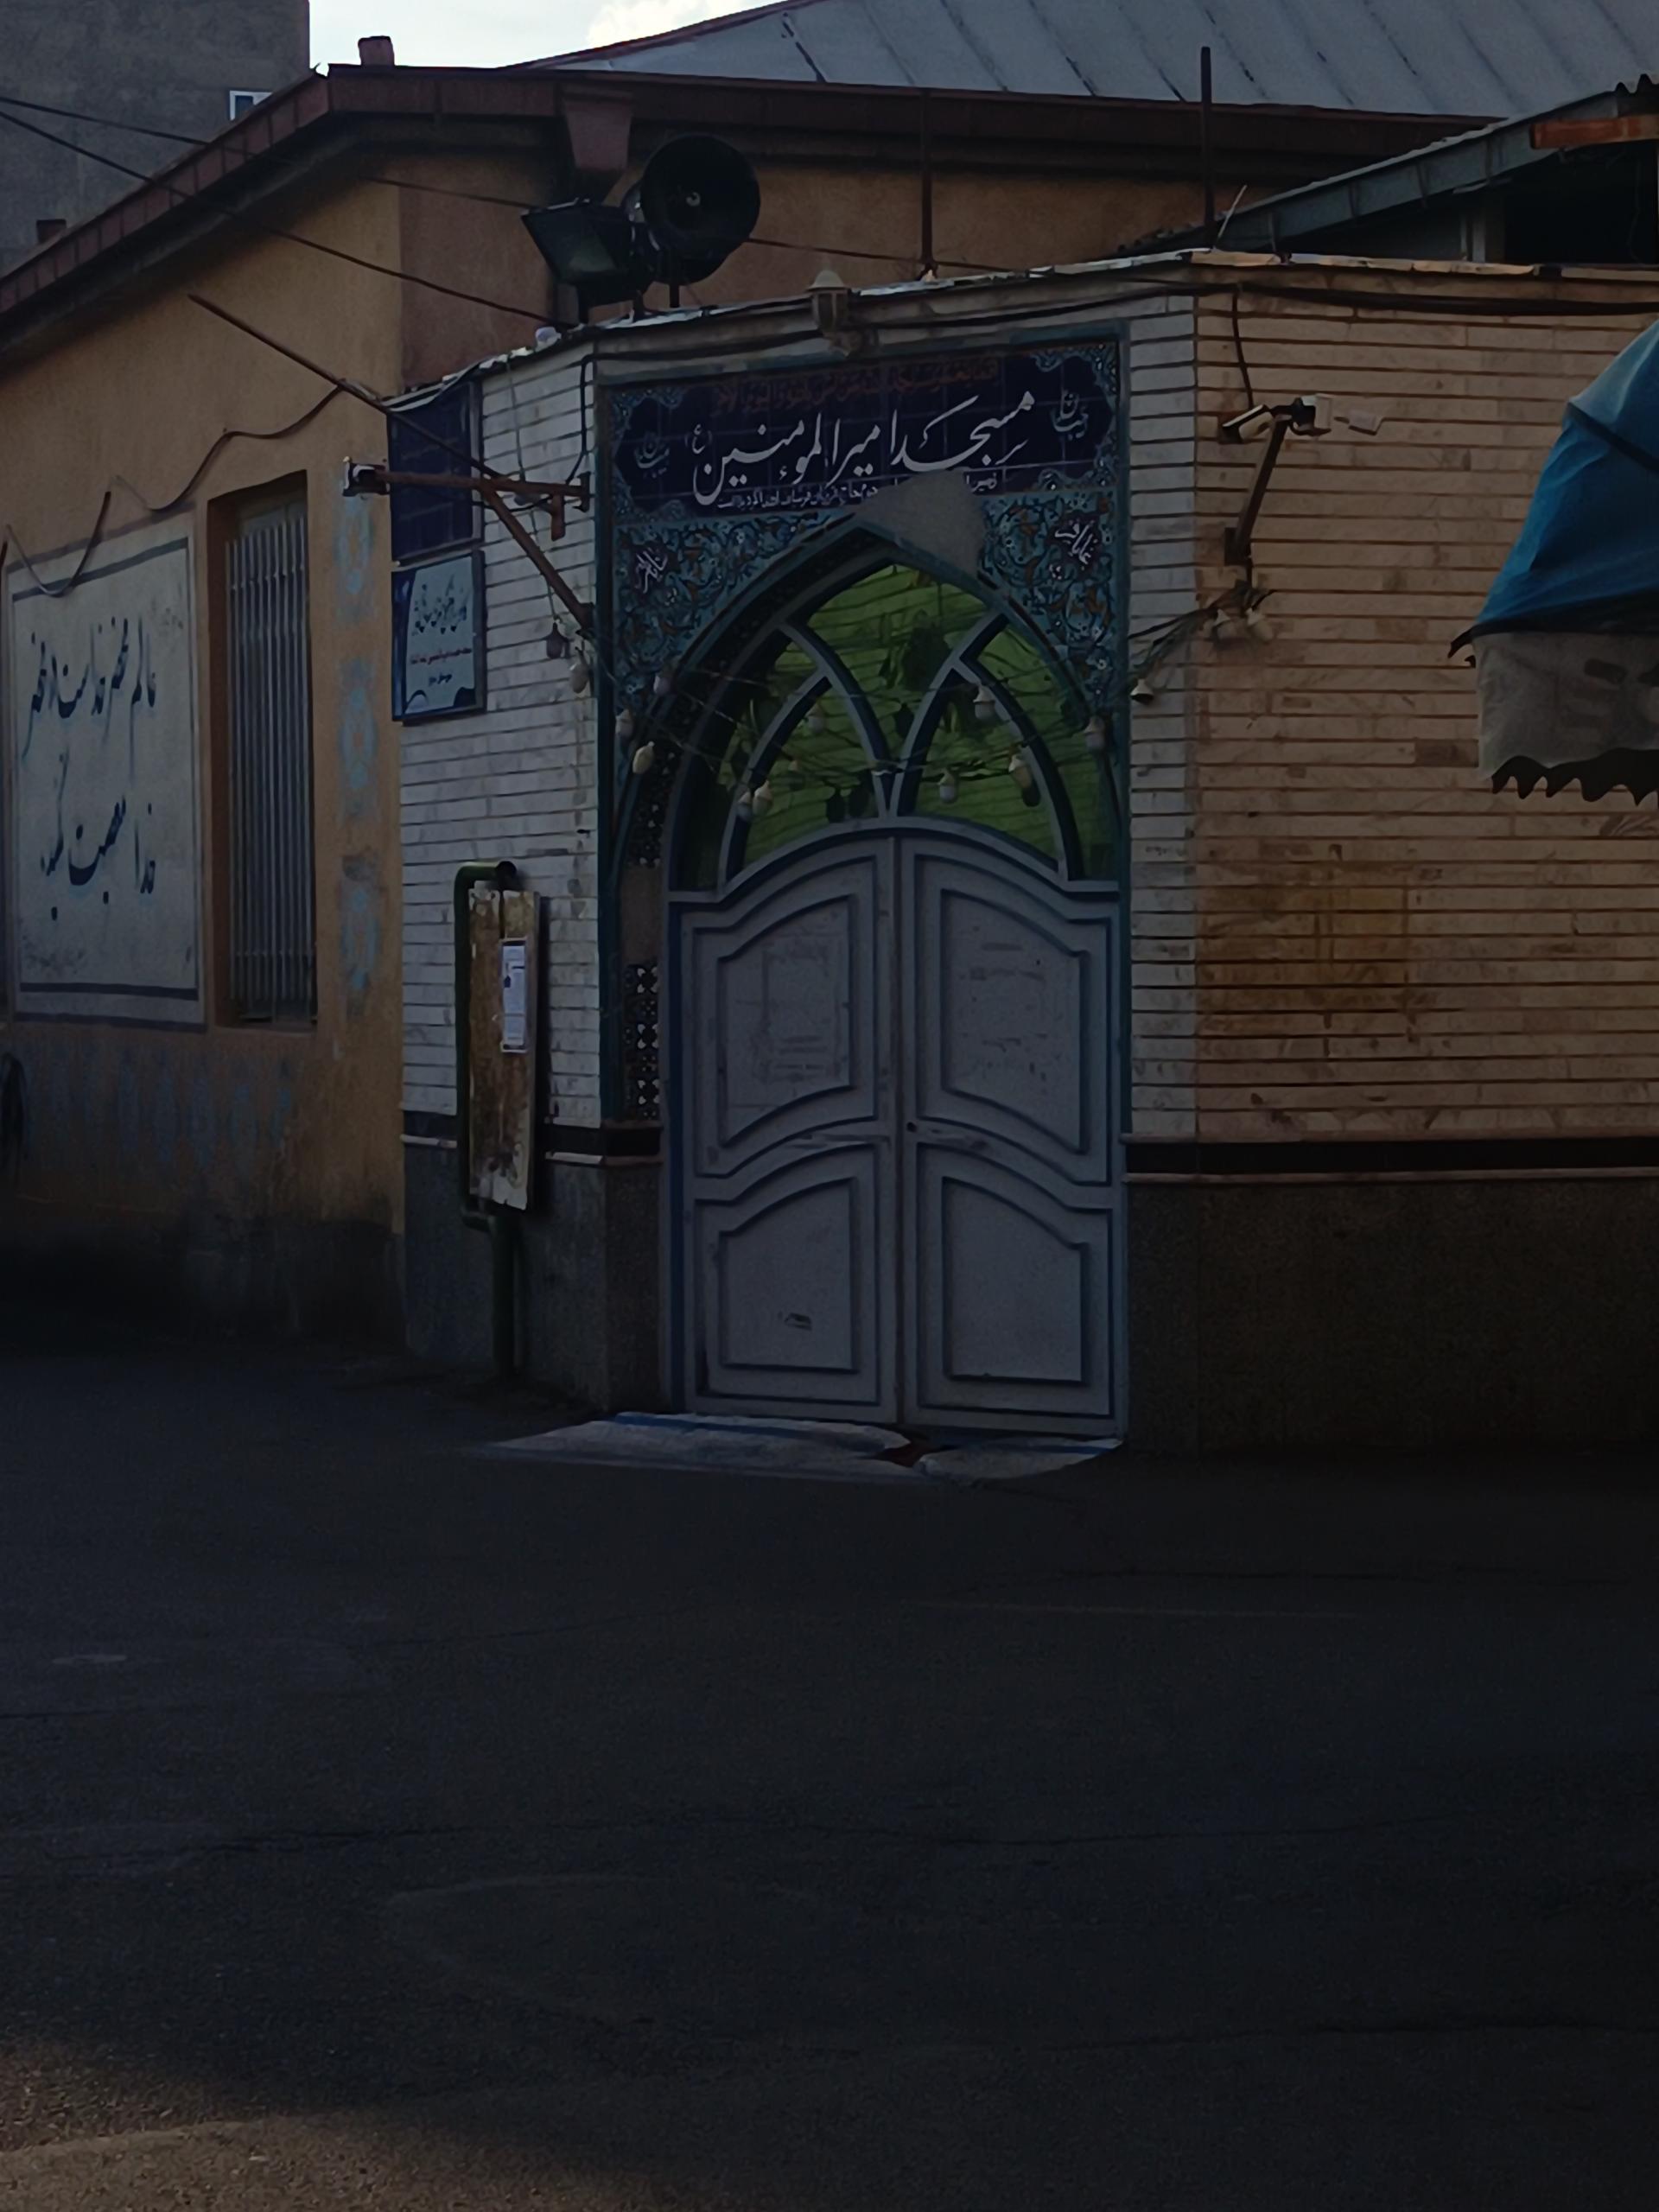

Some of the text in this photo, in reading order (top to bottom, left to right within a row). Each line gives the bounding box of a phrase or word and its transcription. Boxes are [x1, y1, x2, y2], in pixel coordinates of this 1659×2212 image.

[889, 389, 1036, 473] مسجد
[21, 631, 48, 764] محضر
[102, 615, 130, 745] محضر
[129, 612, 157, 782] عالم
[67, 794, 127, 906] معصیت
[134, 801, 156, 894] خدا
